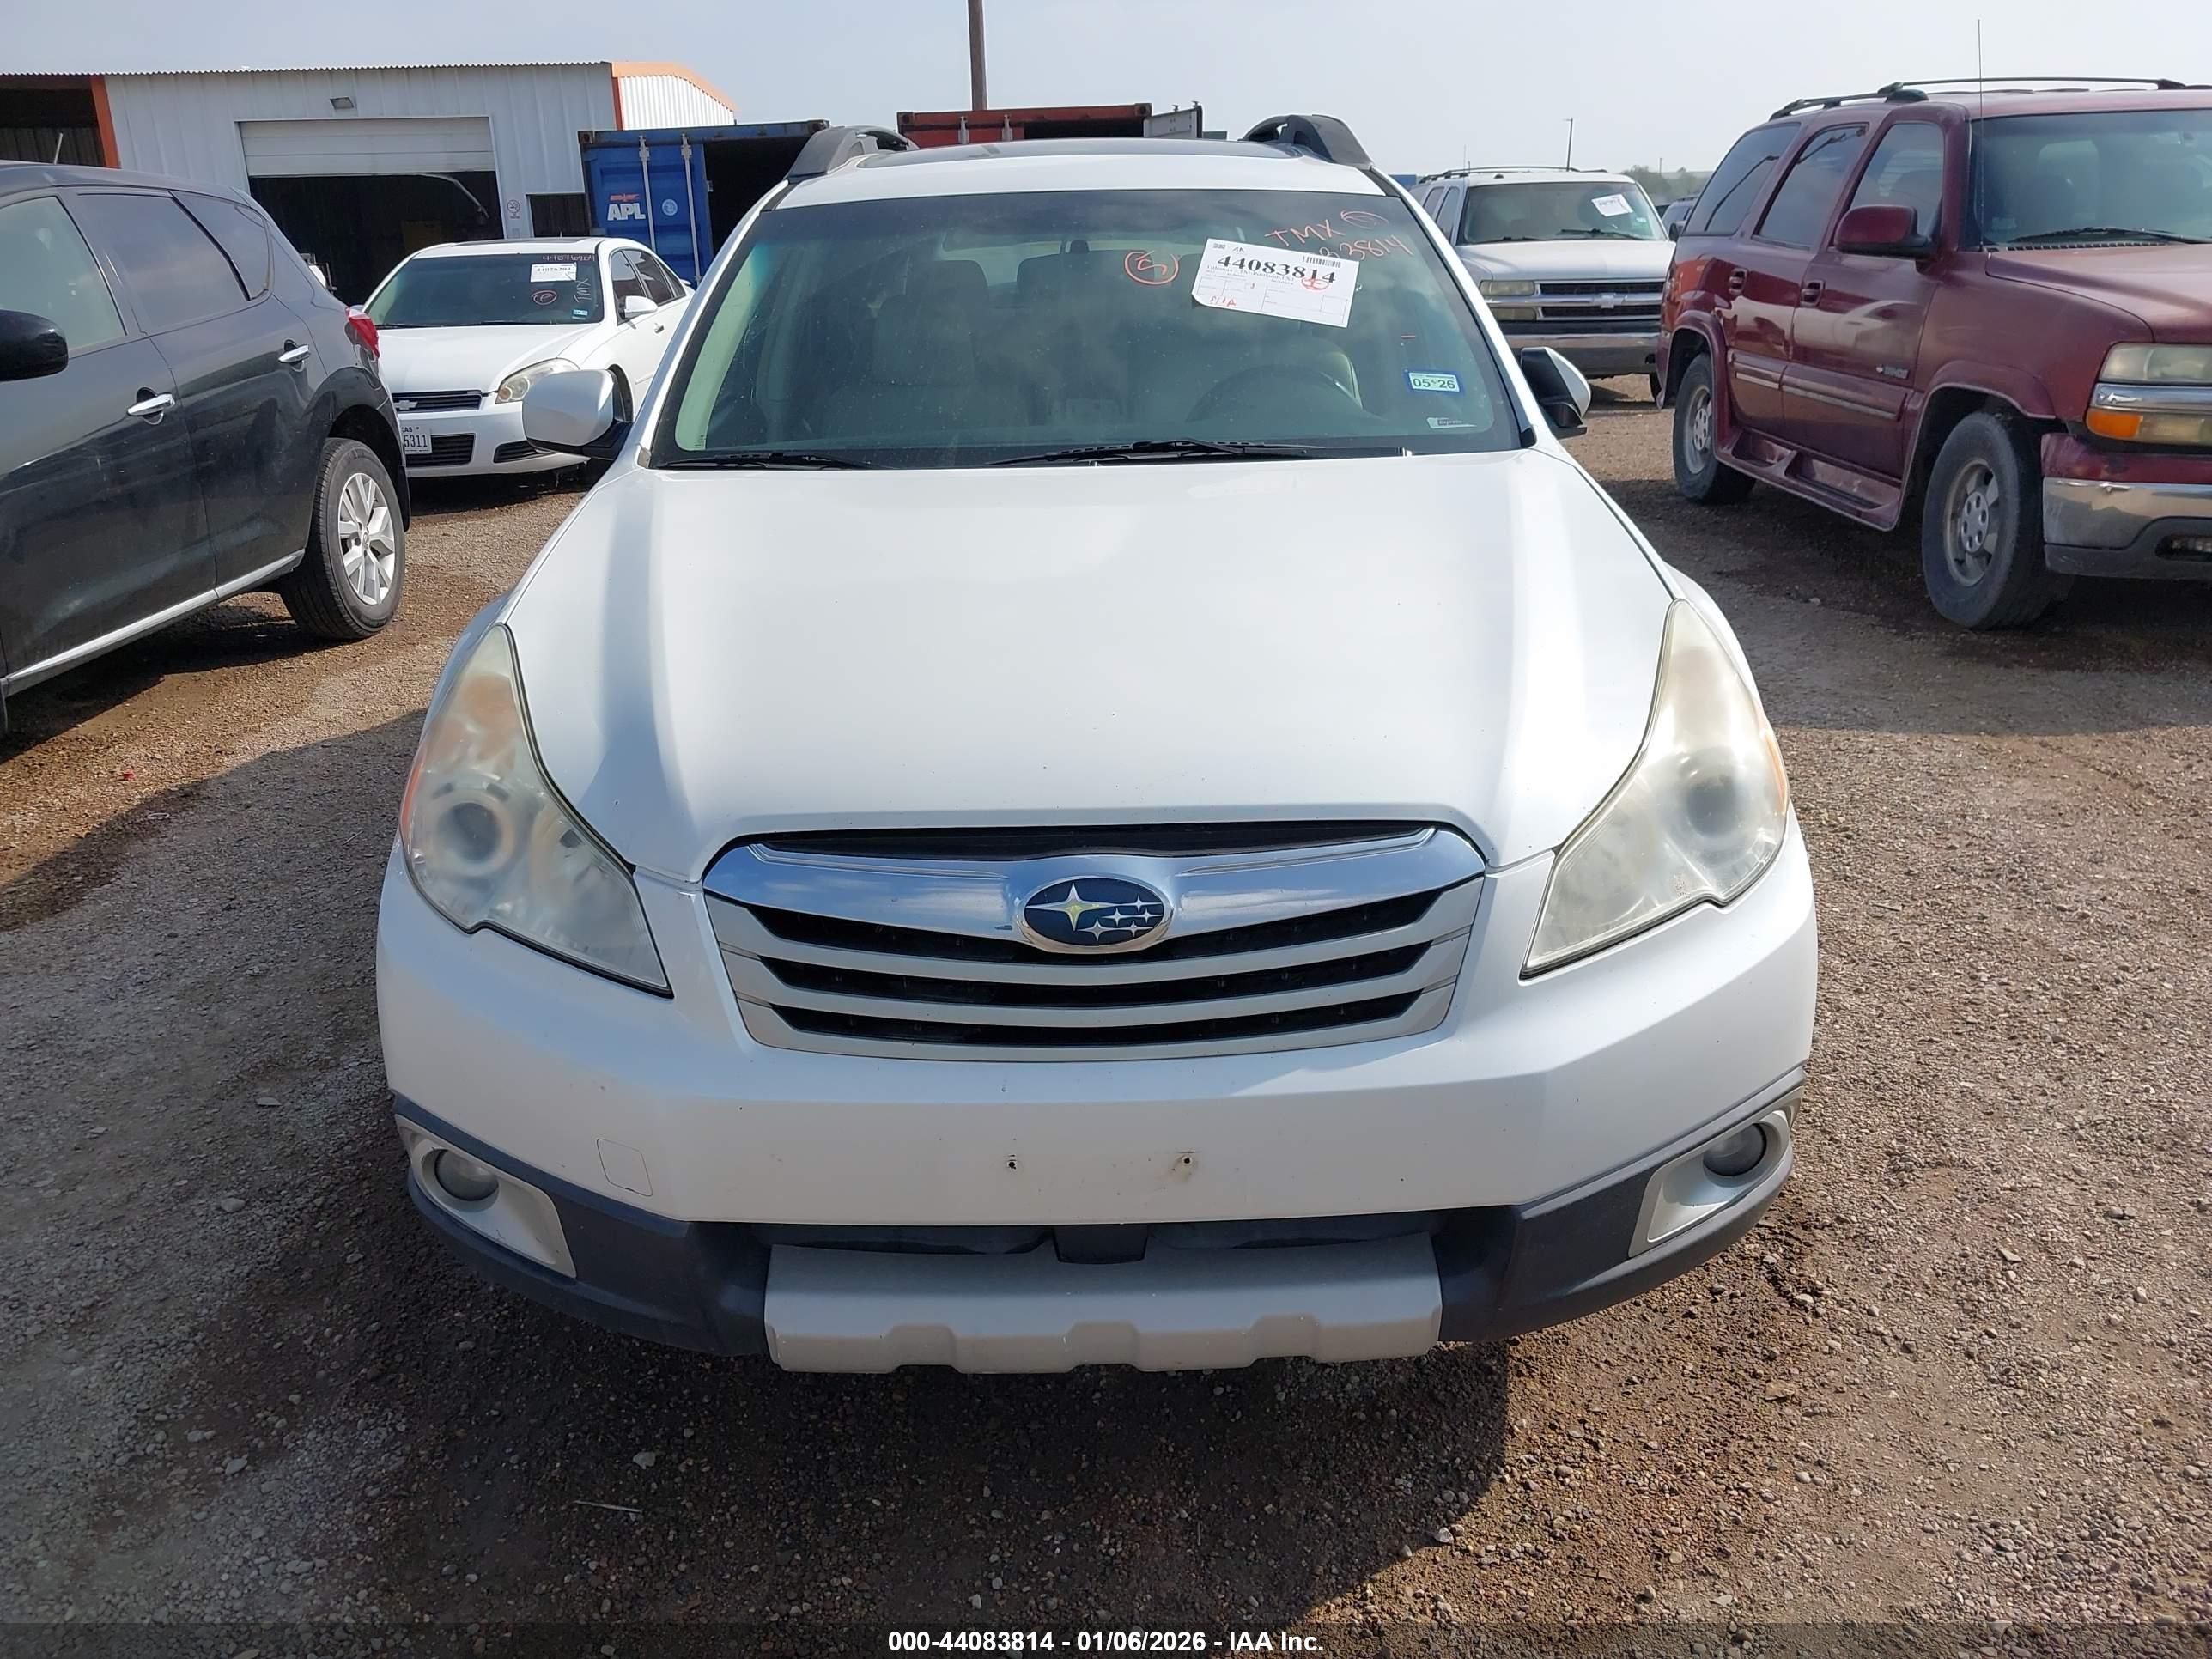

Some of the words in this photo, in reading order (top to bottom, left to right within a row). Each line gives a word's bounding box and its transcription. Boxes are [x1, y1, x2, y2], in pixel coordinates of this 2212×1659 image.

[607, 203, 646, 221] APL
[1264, 219, 1346, 247] TMX
[1217, 255, 1336, 283] 44083814
[1413, 378, 1431, 387] 05
[1437, 379, 1456, 389] 26
